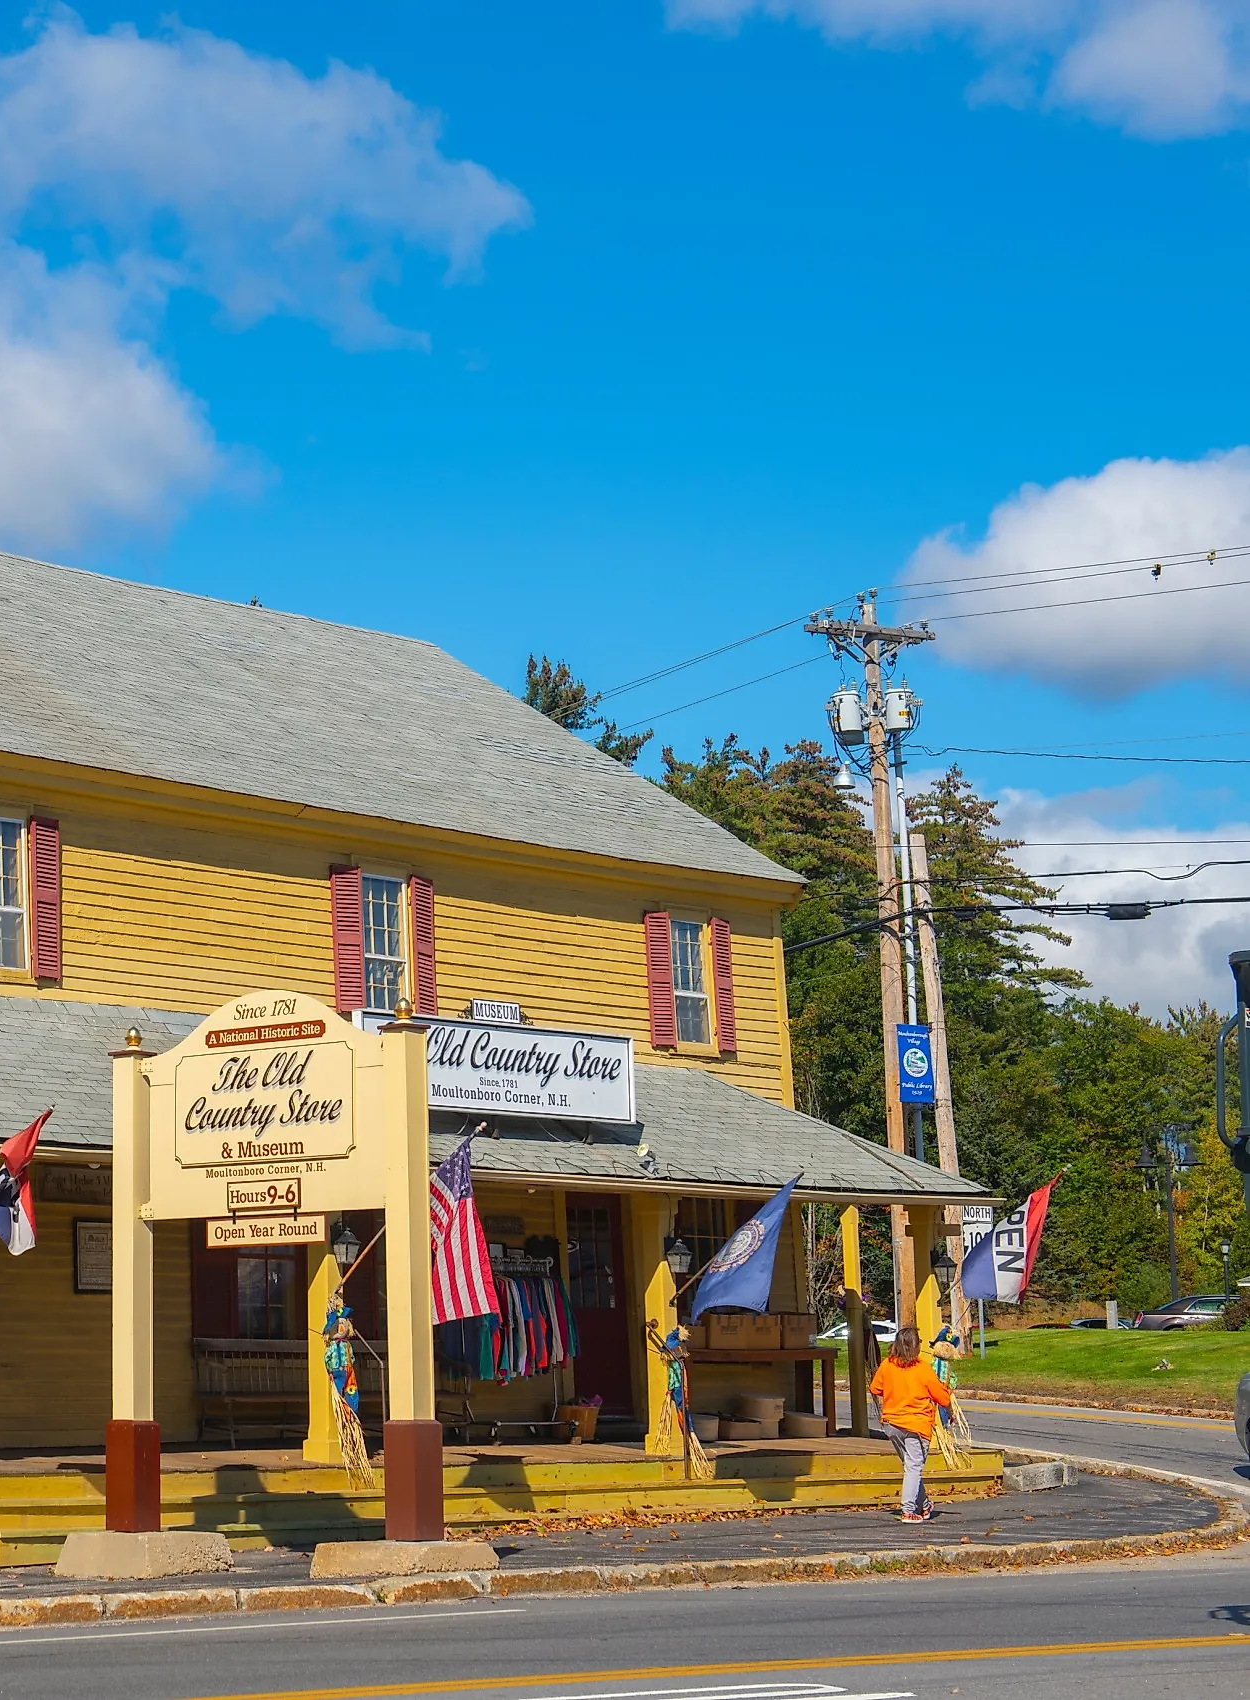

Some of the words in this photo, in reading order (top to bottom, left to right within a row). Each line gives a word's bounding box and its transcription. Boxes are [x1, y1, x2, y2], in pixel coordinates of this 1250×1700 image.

[234, 1004, 267, 1021] Since
[270, 999, 297, 1017] 1781
[475, 1002, 519, 1021] MUSEUM
[208, 1036, 217, 1045] A
[219, 1029, 259, 1043] National
[261, 1025, 300, 1039] Historic
[301, 1023, 321, 1036] Site
[427, 1026, 470, 1067] Old
[471, 1031, 561, 1087] Country
[564, 1040, 622, 1080] Store
[212, 1056, 259, 1092] The
[262, 1050, 313, 1088] Old
[502, 1079, 518, 1089] 1781
[916, 1082, 932, 1091] Library
[432, 1084, 501, 1102] Moultonboro
[505, 1090, 544, 1107] Corner,
[548, 1094, 571, 1107] N.H.
[185, 1097, 277, 1137] Country
[279, 1089, 343, 1124] Store
[221, 1142, 233, 1159] &
[238, 1141, 304, 1158] Museum
[206, 1167, 265, 1178] Moultonboro
[268, 1164, 302, 1175] Corner,
[305, 1162, 327, 1172] N.H.
[230, 1190, 266, 1204] Hours
[267, 1184, 296, 1204] 9-6
[963, 1206, 991, 1219] NORTH
[214, 1226, 246, 1241] Open
[249, 1224, 275, 1237] Year
[278, 1222, 318, 1236] Round
[969, 1231, 989, 1250] 10
[995, 1210, 1025, 1274] PEN
